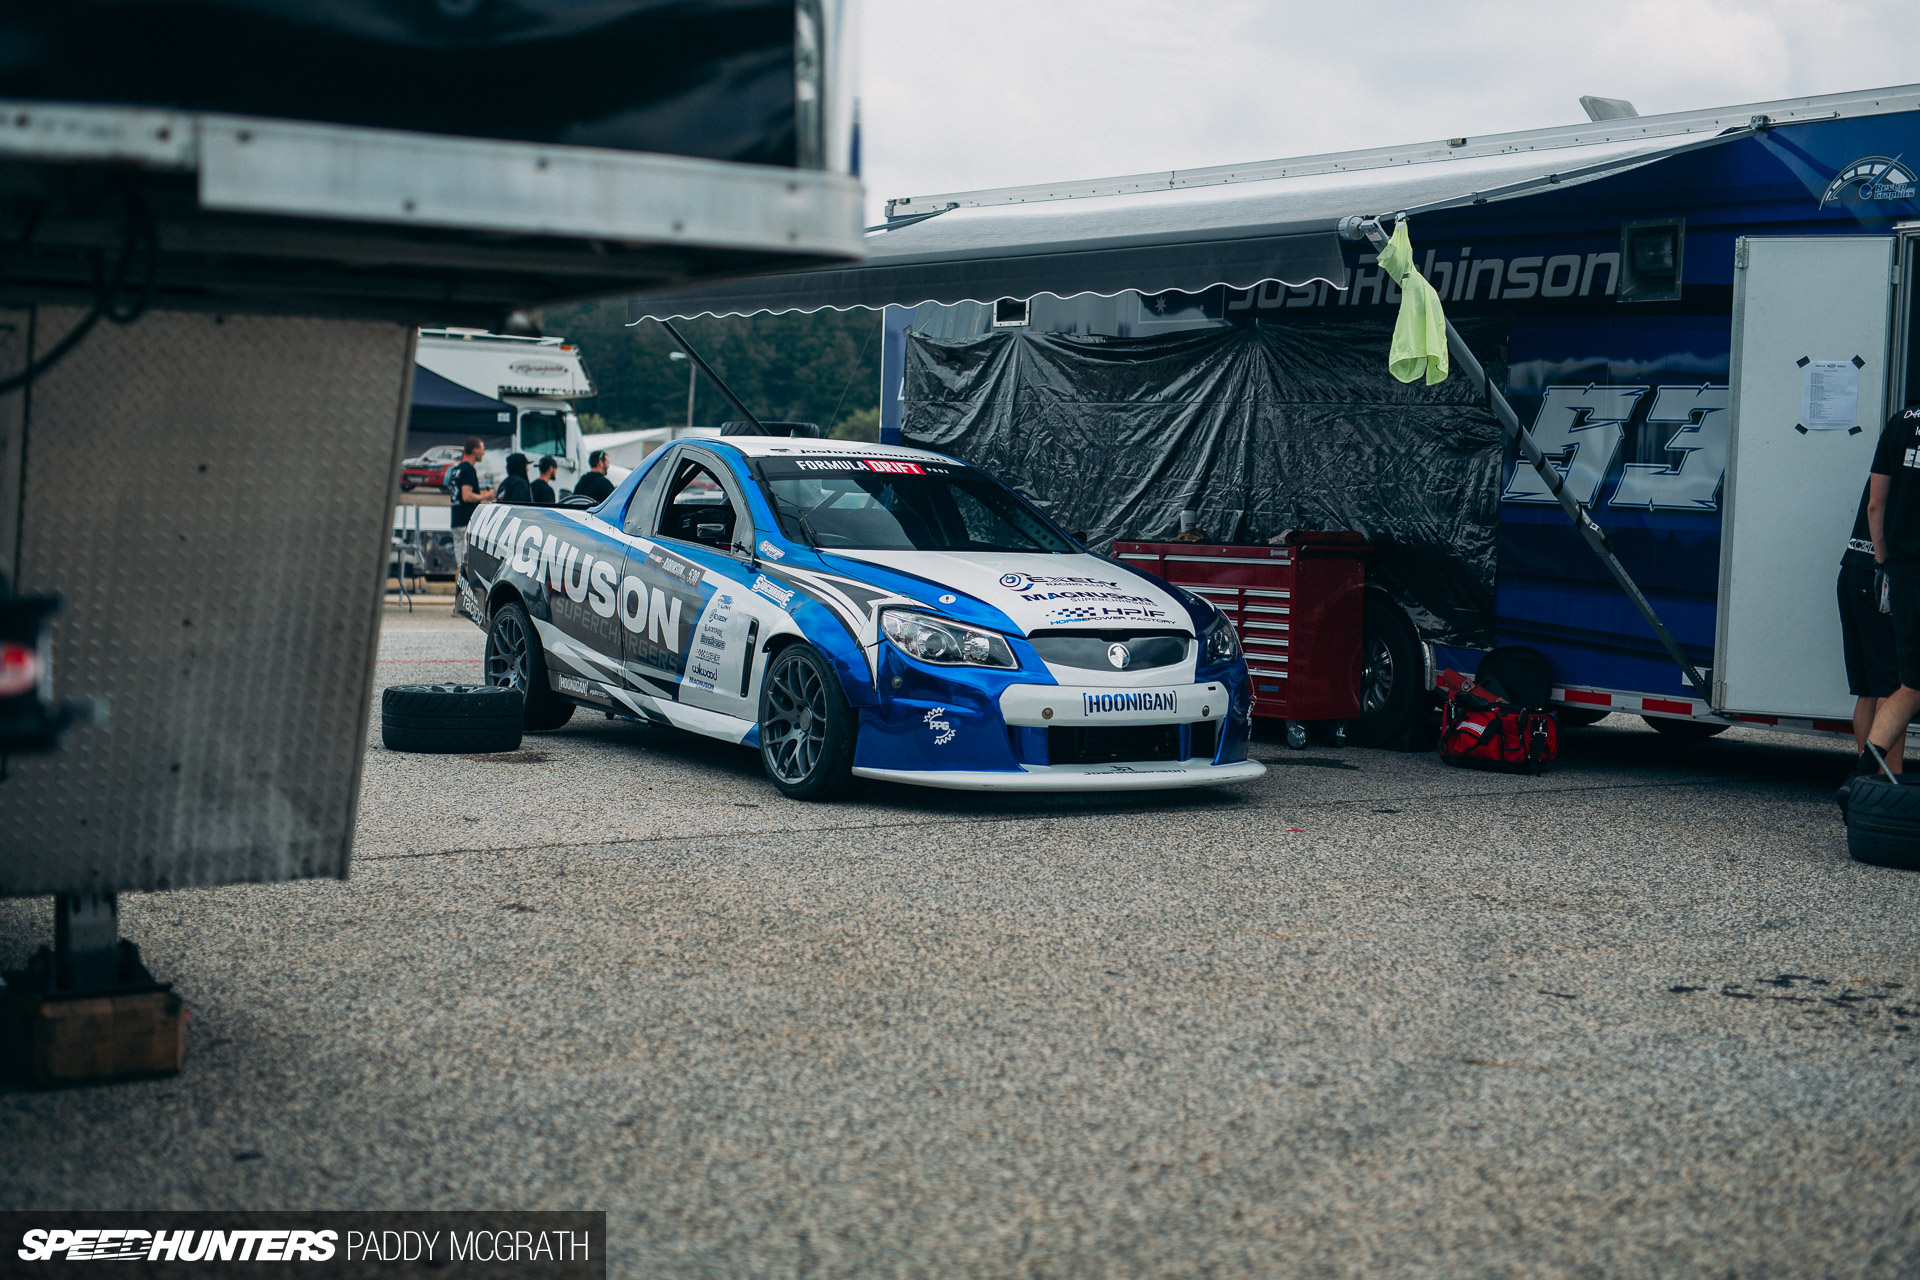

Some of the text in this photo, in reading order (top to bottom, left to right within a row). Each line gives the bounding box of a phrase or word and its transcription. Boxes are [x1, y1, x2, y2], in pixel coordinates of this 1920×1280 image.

[795, 460, 871, 471] FORMULA
[867, 460, 921, 475] DRIFT
[470, 504, 683, 655] MAGNUSON
[1026, 576, 1118, 588] EXEDY
[1020, 591, 1155, 604] MAGNUSON
[1050, 616, 1177, 626] HORSEPOWER FACTORY
[929, 720, 950, 731] PPG
